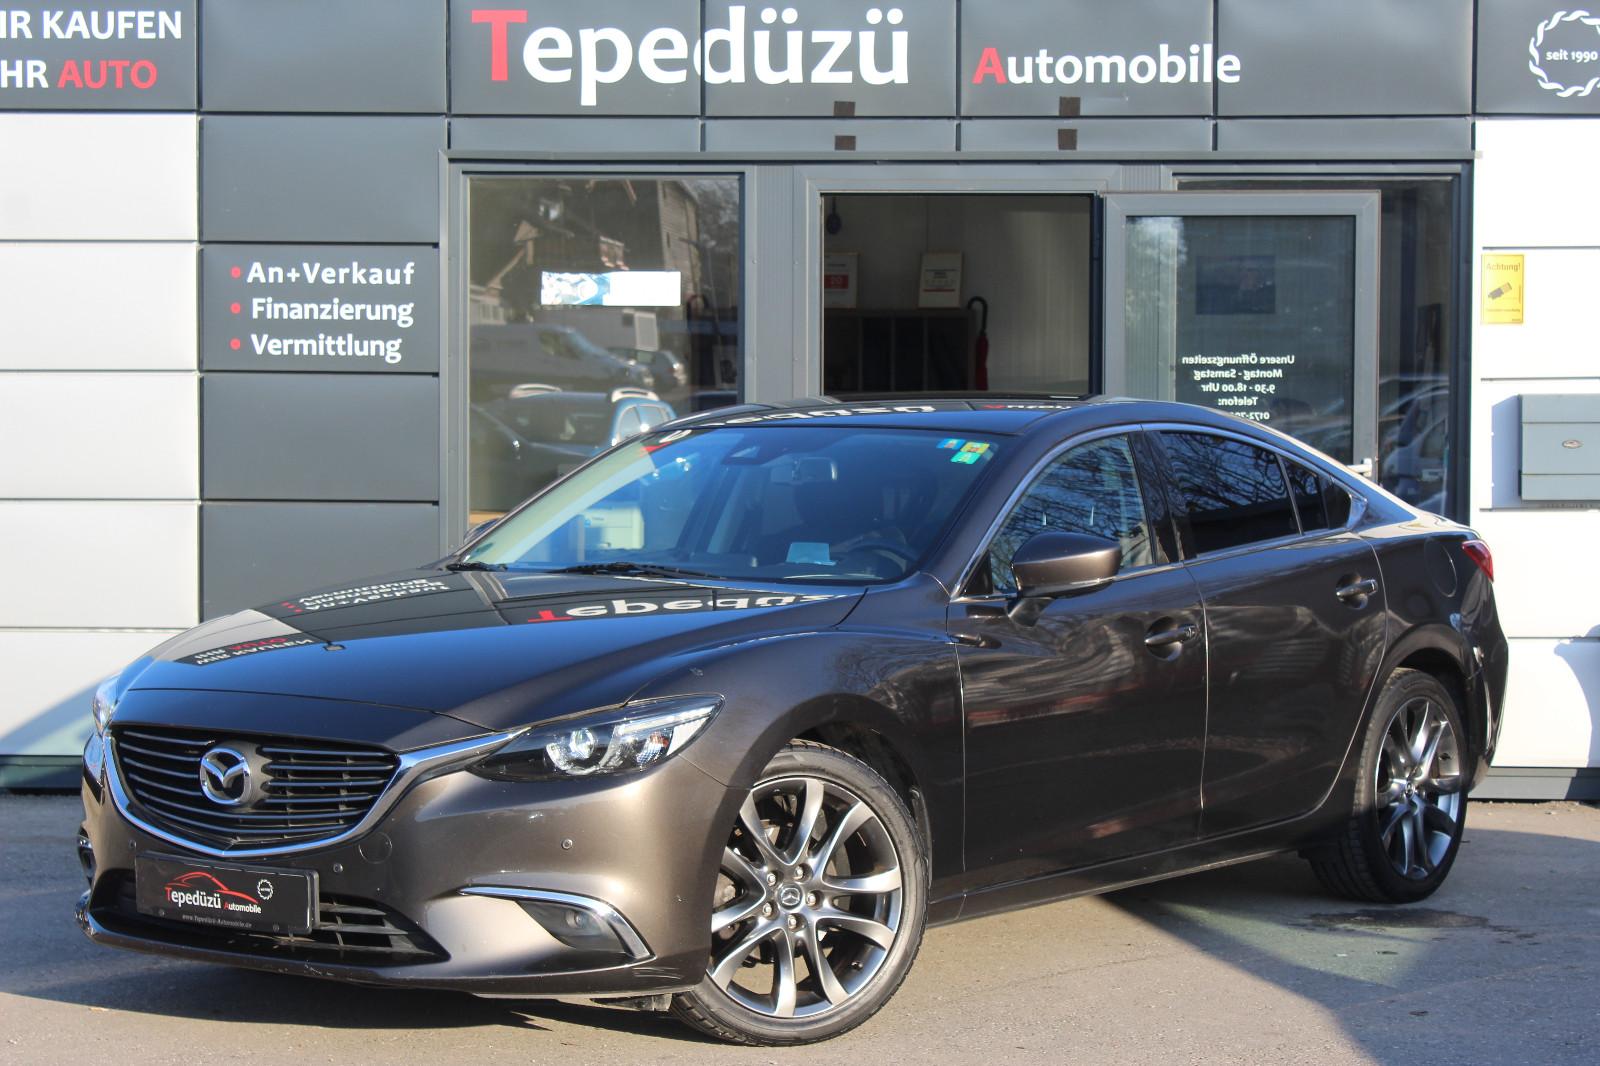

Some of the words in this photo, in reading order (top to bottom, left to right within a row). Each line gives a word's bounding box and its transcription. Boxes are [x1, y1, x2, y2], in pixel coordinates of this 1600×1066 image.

[43, 10, 182, 40] KAUFEN
[470, 5, 909, 106] Tepedüzü
[971, 43, 1242, 84] Automobile
[1546, 49, 1569, 61] seit
[1571, 51, 1598, 63] 1990
[57, 59, 158, 90] AUTO
[246, 261, 416, 286] An+Verkauf
[1487, 263, 1521, 272] Achtung!
[251, 297, 415, 328] Finanzierung
[250, 333, 402, 364] Vermittlung
[164, 886, 221, 909] Tepedüzü
[224, 901, 262, 914] Automobile
